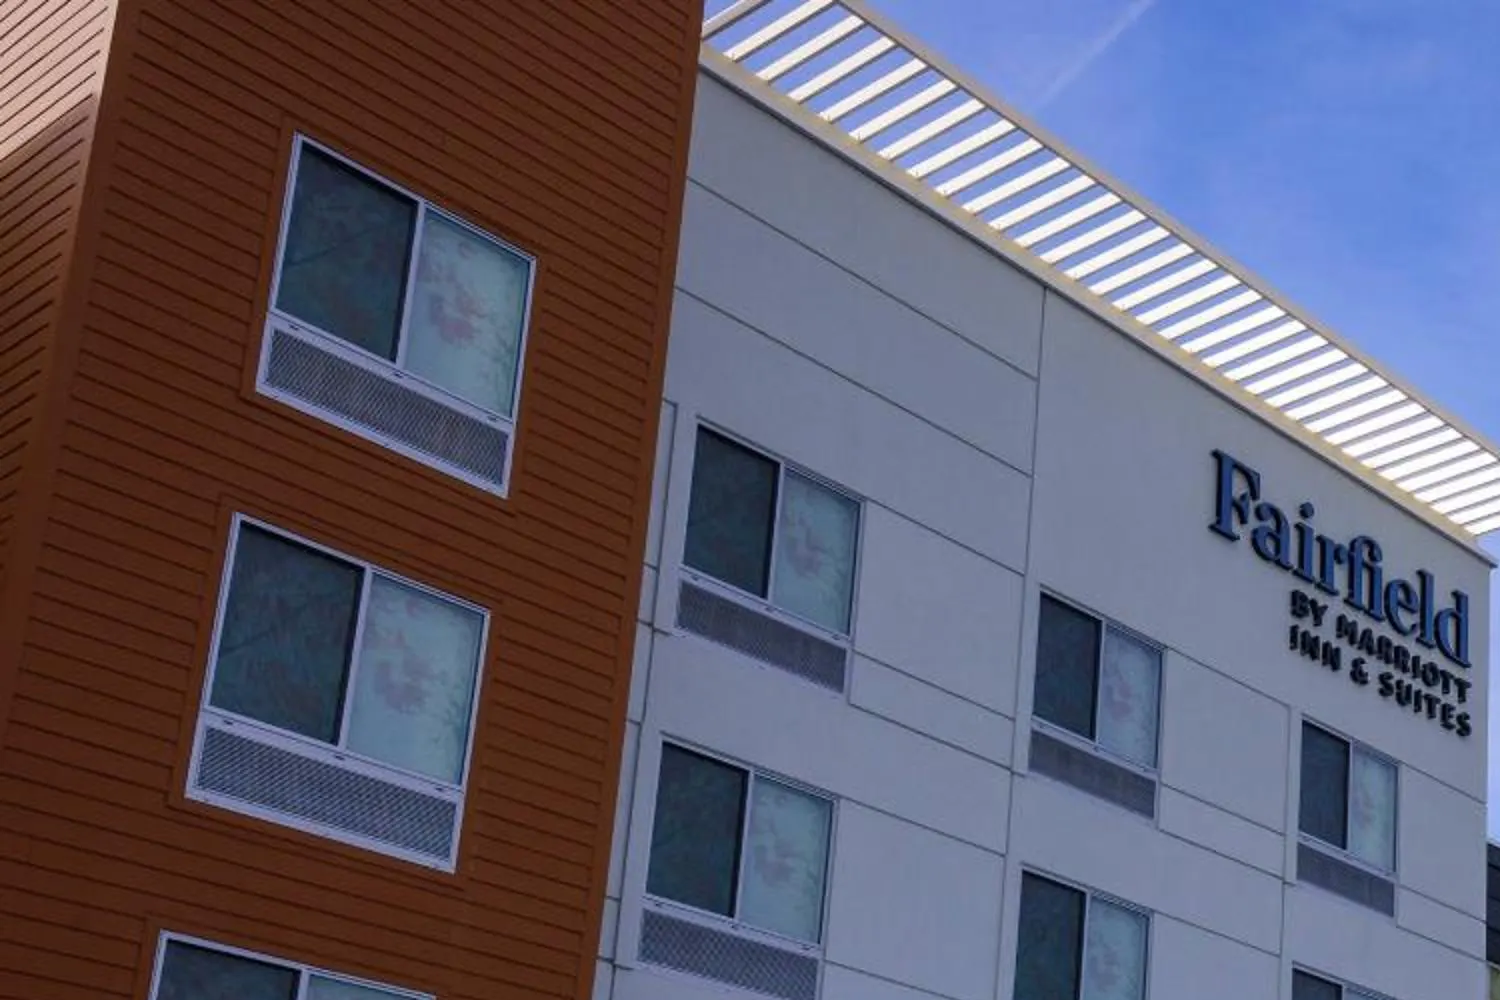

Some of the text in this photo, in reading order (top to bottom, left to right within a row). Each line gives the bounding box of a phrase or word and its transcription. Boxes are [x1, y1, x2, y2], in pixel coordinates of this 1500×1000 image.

[1208, 448, 1472, 669] Fairfield
[1289, 624, 1472, 737] INN & SUITES
[1290, 589, 1472, 704] BY MARRIOTT
